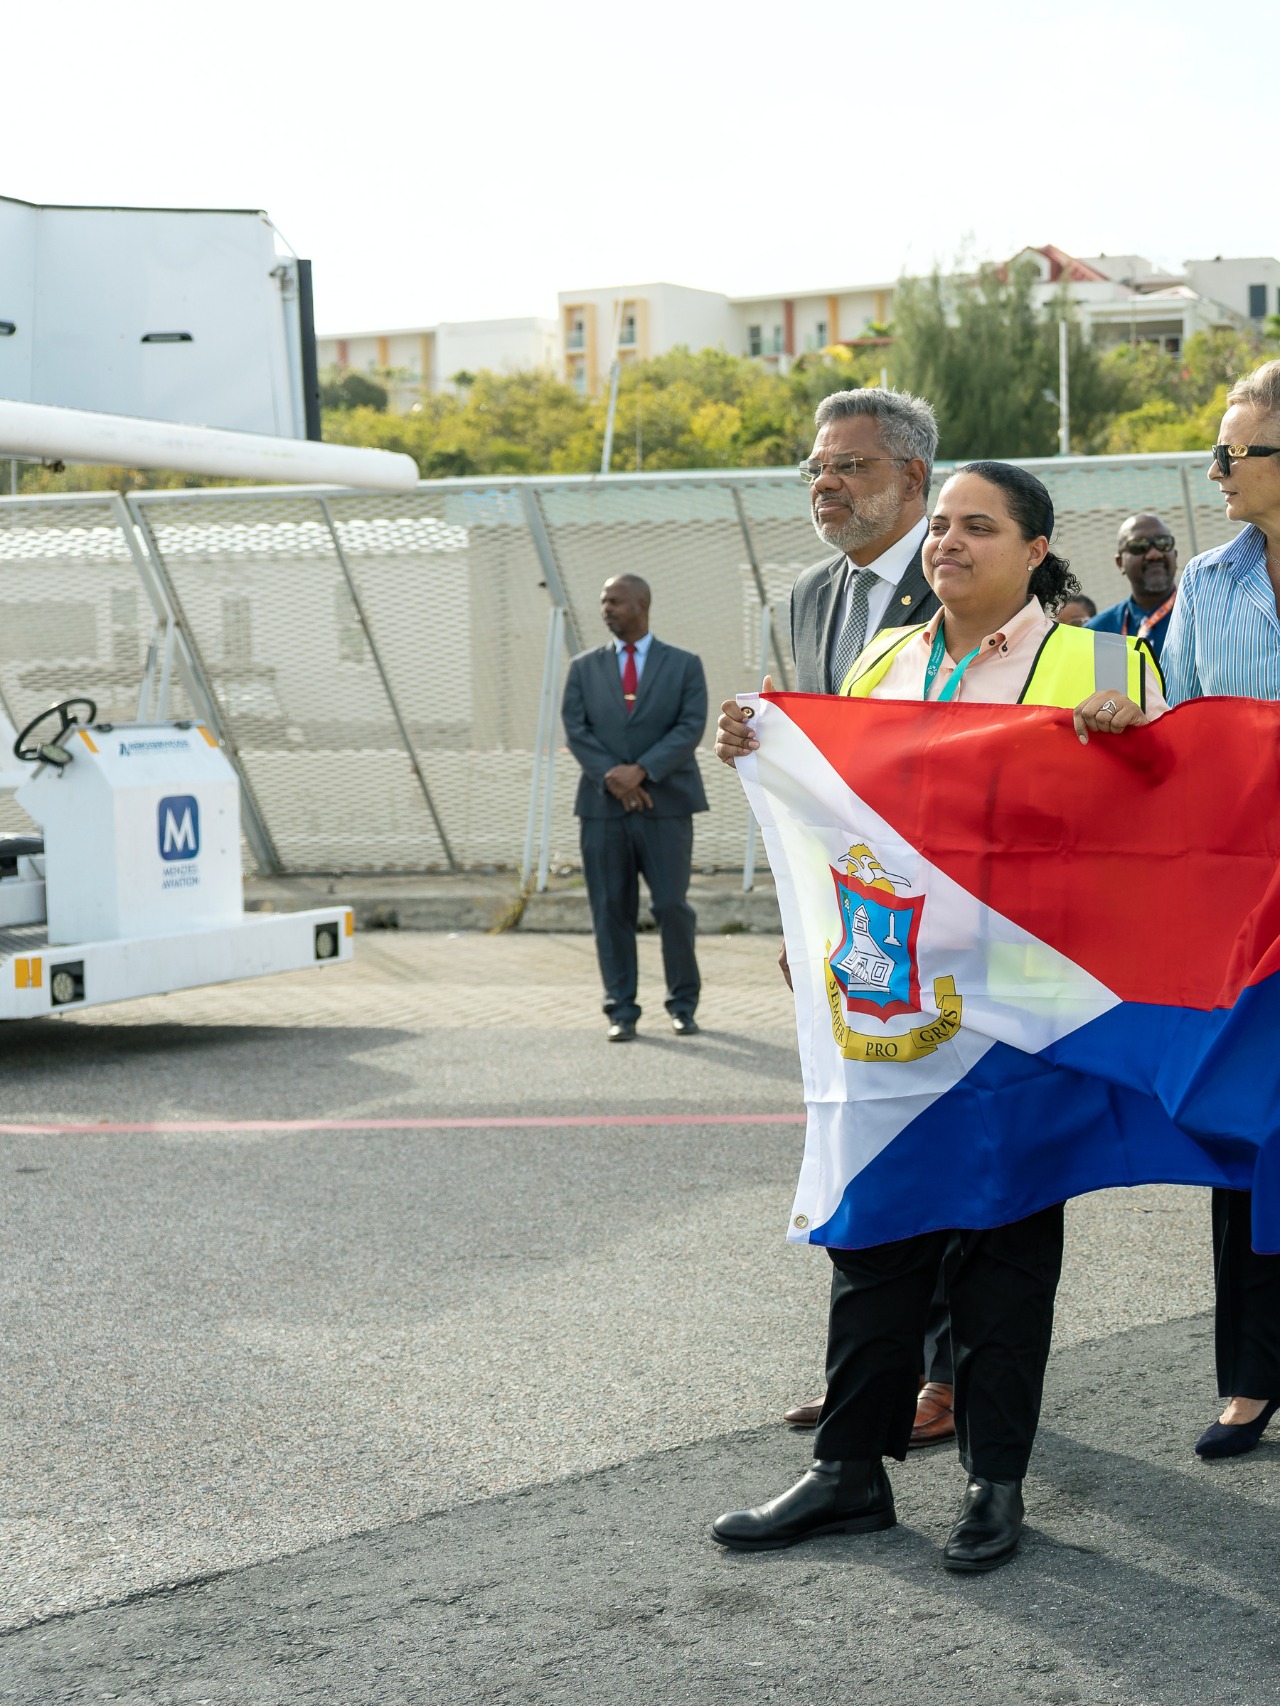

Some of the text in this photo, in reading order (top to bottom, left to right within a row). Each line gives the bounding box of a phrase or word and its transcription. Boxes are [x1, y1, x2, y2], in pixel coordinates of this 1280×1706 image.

[163, 806, 197, 853] M
[829, 981, 845, 1042] SEMPER
[865, 1042, 898, 1057] PRO
